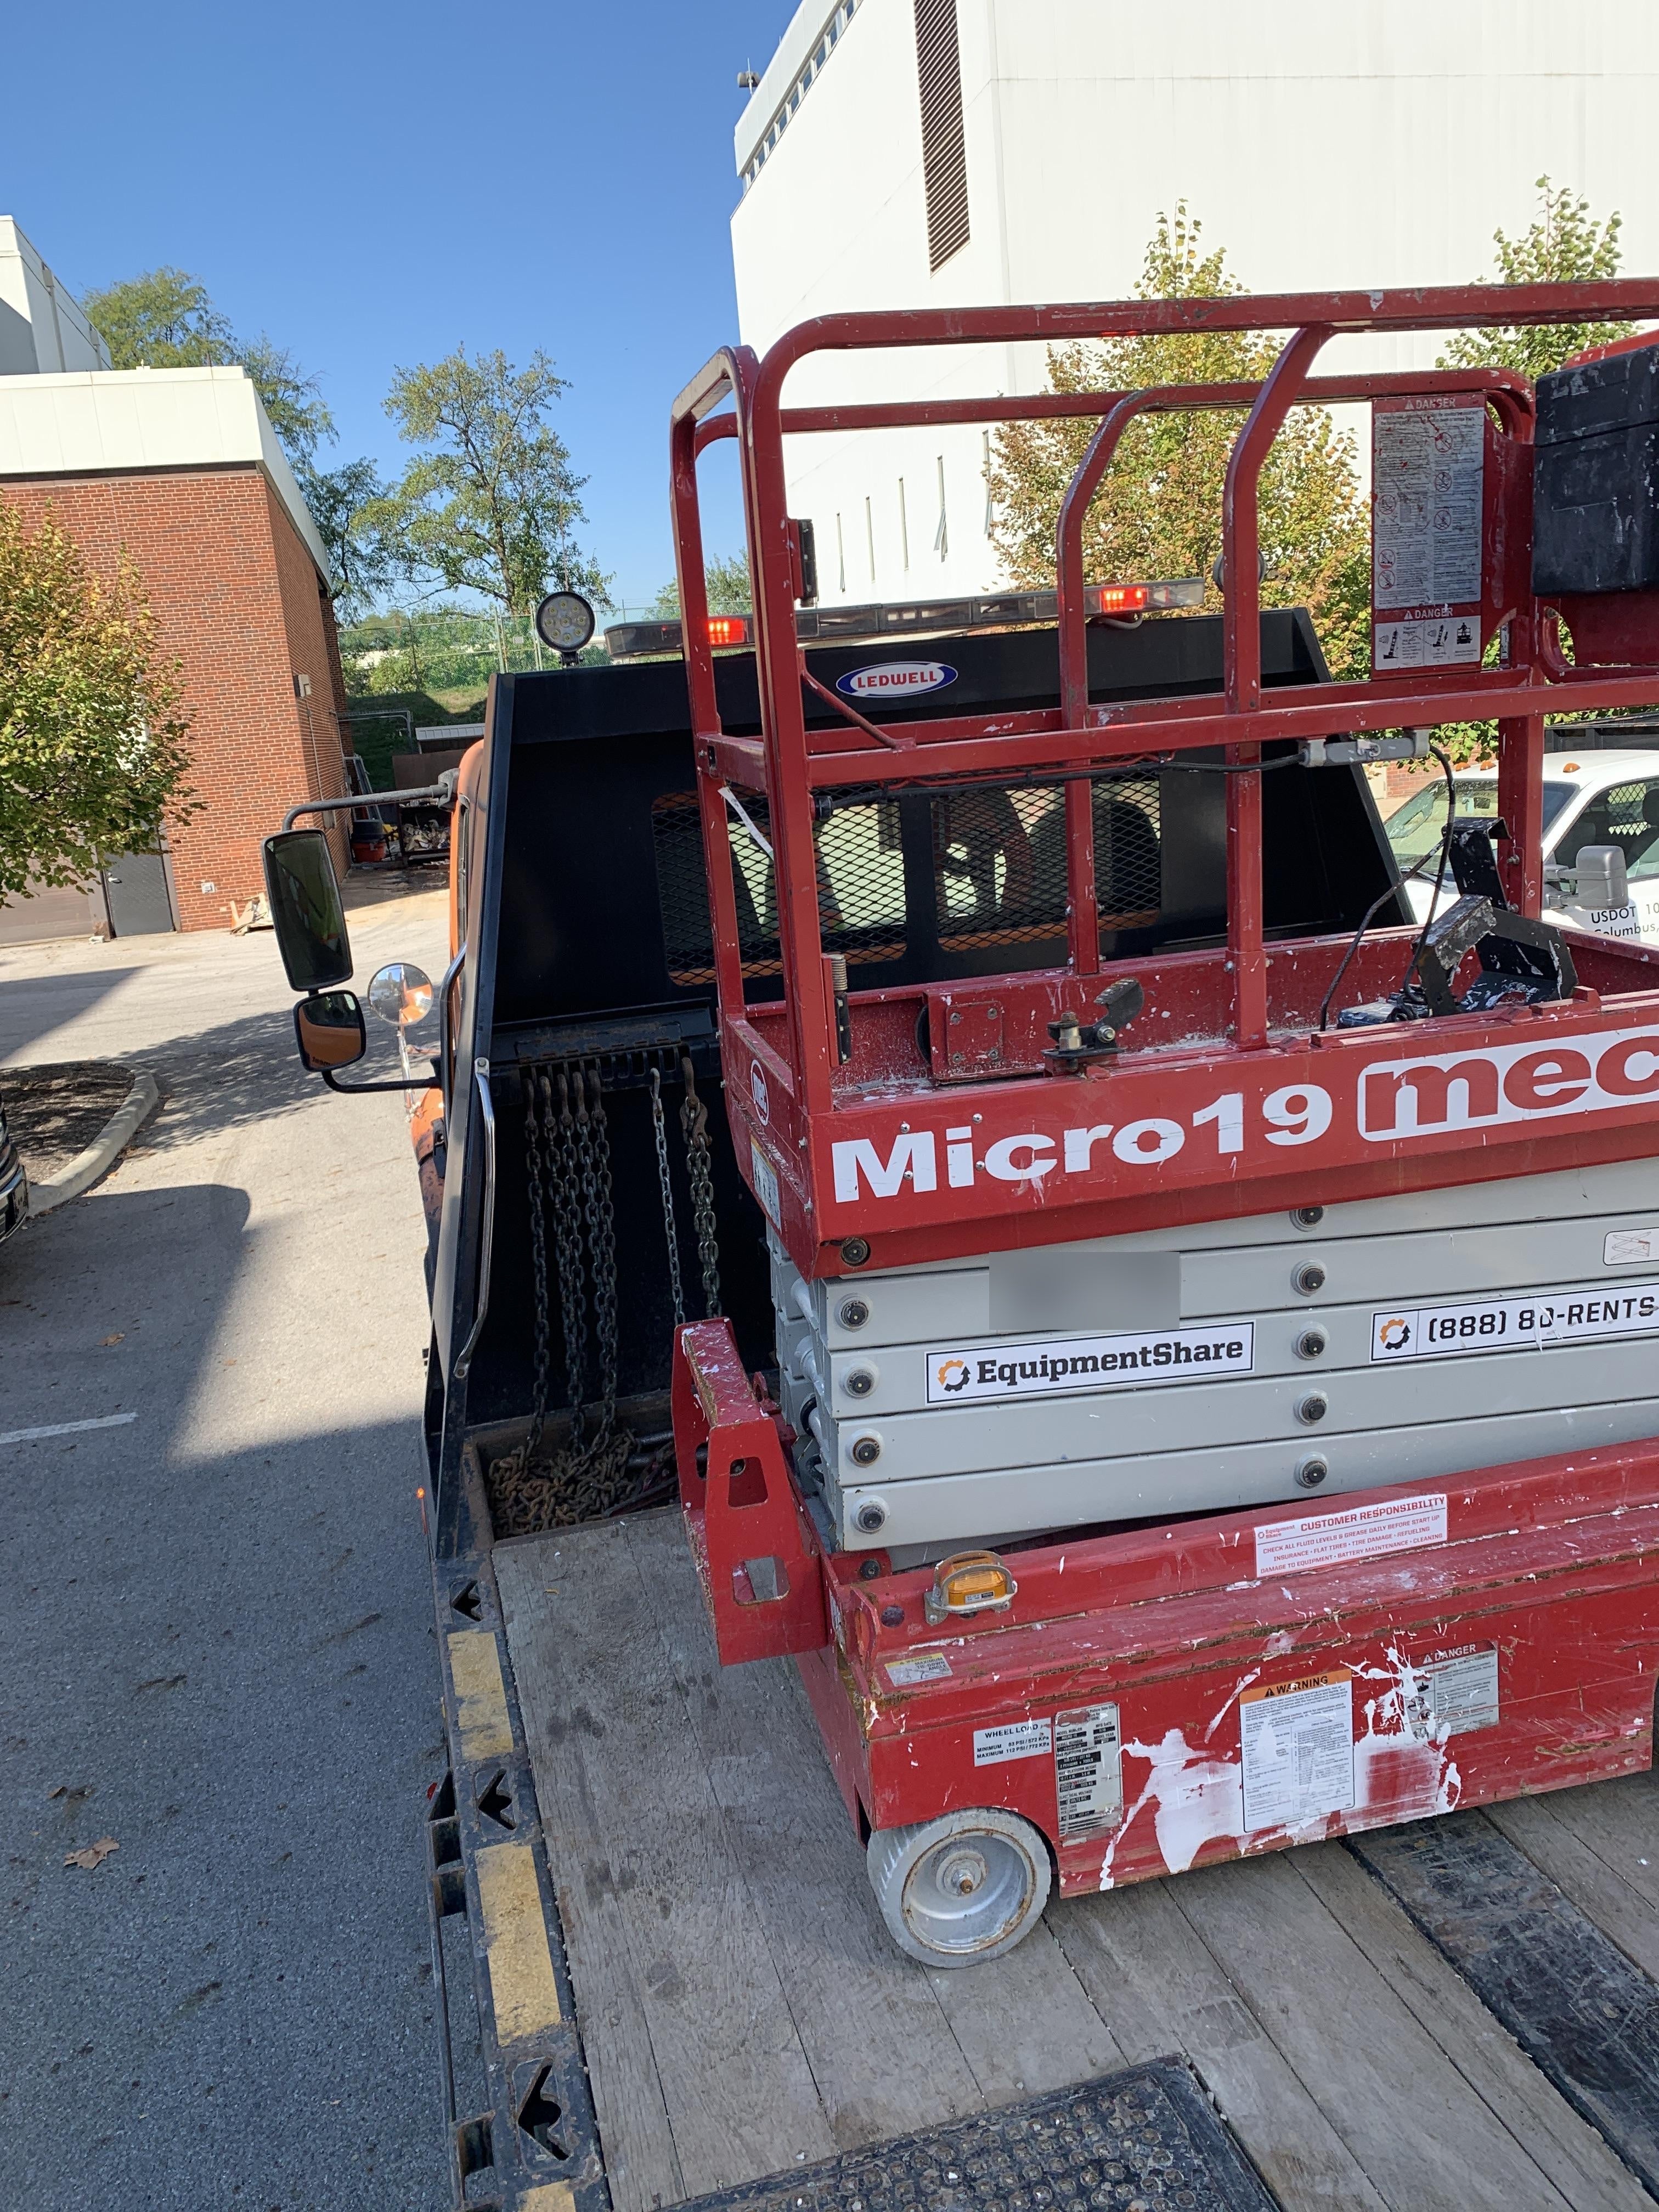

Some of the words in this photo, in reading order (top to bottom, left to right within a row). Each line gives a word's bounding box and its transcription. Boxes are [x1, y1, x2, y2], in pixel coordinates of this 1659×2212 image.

[1416, 398, 1455, 409] DANGER
[1415, 607, 1453, 619] DANGER
[857, 671, 937, 688] LEDWELL
[1591, 906, 1636, 923] USDOT
[831, 1084, 1333, 1203] Micro19
[1365, 1035, 1659, 1132] mec
[1429, 1311, 1505, 1342] (888)
[1518, 1296, 1655, 1330] 80-RENTS
[977, 1341, 1243, 1386] EquipmentShare
[1301, 1514, 1357, 1532] CUSTOMER
[1360, 1497, 1444, 1520] RESPONSIBILITY
[1263, 1545, 1283, 1554] CHECK
[1316, 1534, 1337, 1543] LEVELS
[1344, 1528, 1368, 1538] GREASE
[1369, 1525, 1386, 1533] DAILY
[1388, 1520, 1410, 1529] BEFORE
[1412, 1516, 1430, 1525] START
[1265, 1525, 1295, 1534] Equipment
[1274, 1550, 1309, 1561] INSURANCE
[1367, 1534, 1393, 1543] DAMAGE
[1397, 1527, 1430, 1537] REFUELING
[1261, 1565, 1286, 1573] DAMAGE
[1297, 1555, 1333, 1566] EQUIPMENT
[1338, 1548, 1363, 1558] BATTERY
[1365, 1540, 1408, 1553] MAINTENANCE
[1413, 1533, 1443, 1543] CLEANING
[1435, 1644, 1476, 1661] DANGER
[915, 1657, 943, 1666] MAXIMUM
[1277, 1675, 1328, 1694] WARNING
[985, 1729, 1014, 1739] WHEEL
[1016, 1724, 1038, 1733] LOAD
[977, 1744, 1002, 1752] MINIMUM
[977, 1750, 1003, 1759] MAXIMUM
